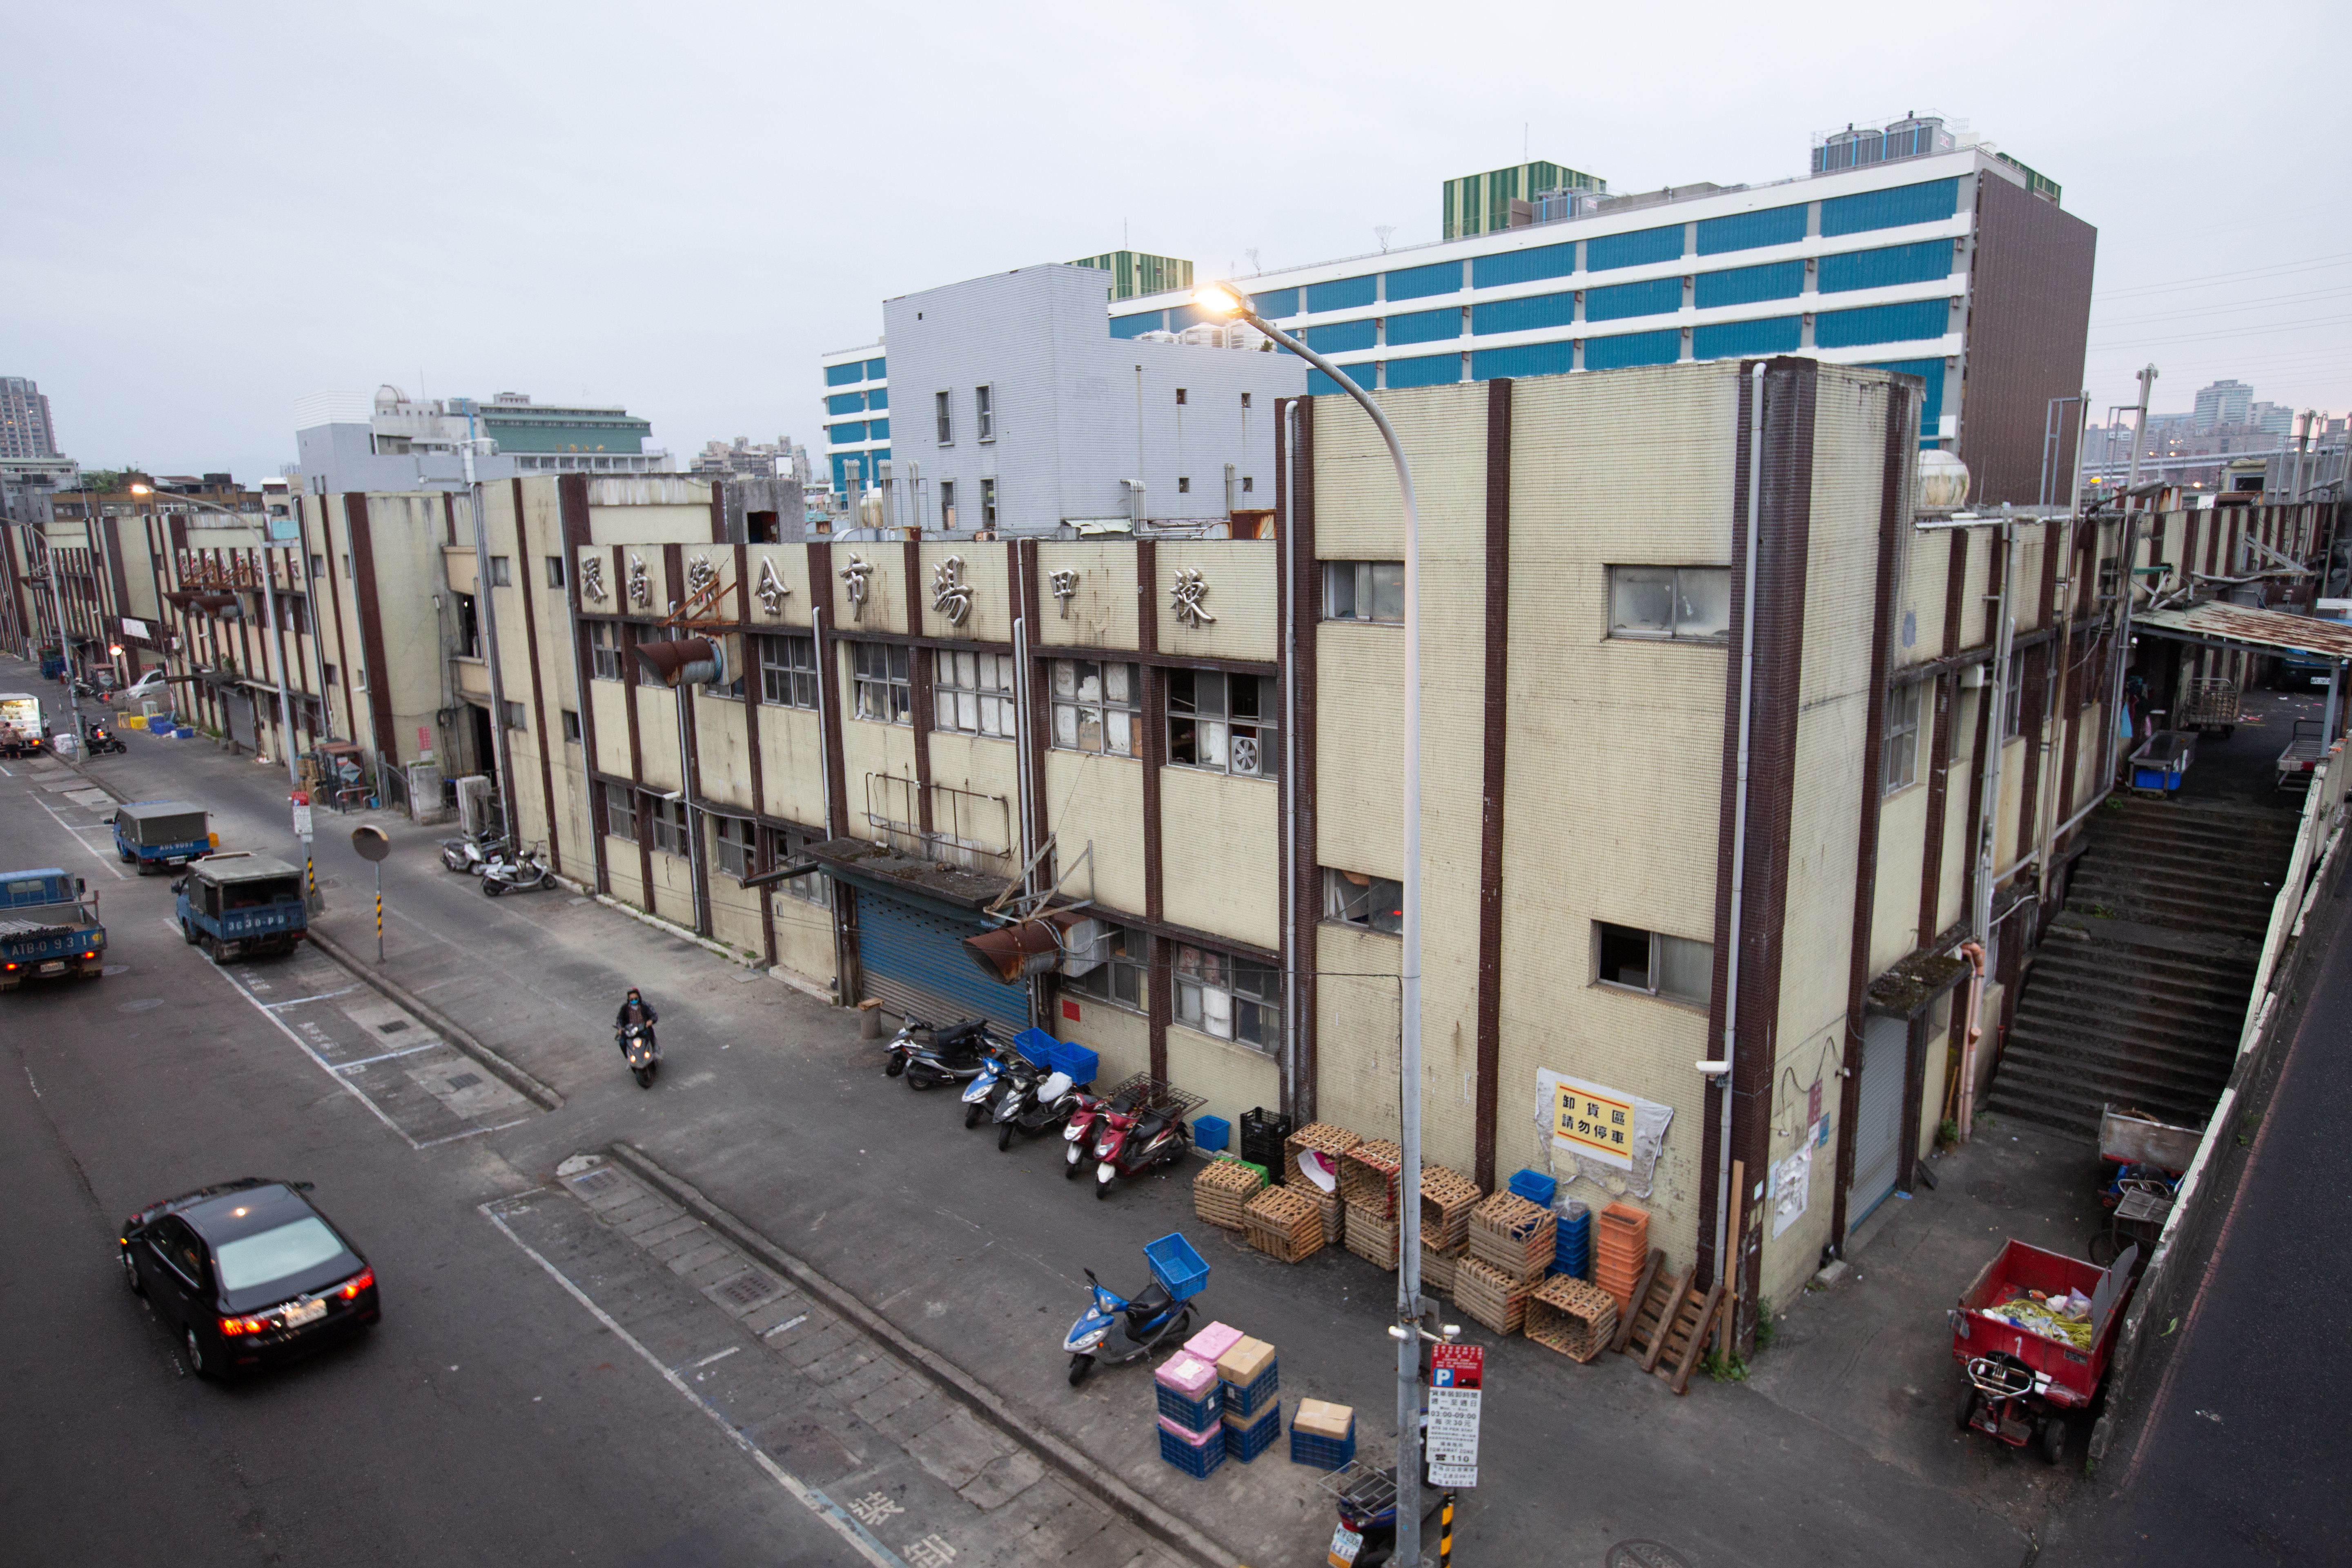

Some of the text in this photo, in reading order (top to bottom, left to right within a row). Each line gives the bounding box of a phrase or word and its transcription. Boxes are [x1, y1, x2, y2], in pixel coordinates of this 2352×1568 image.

[1563, 1094, 1625, 1126] 卸貨區
[1562, 1114, 1624, 1144] 請勿停車
[1436, 1368, 1450, 1385] P
[1431, 1410, 1476, 1419] 03:00-09:00
